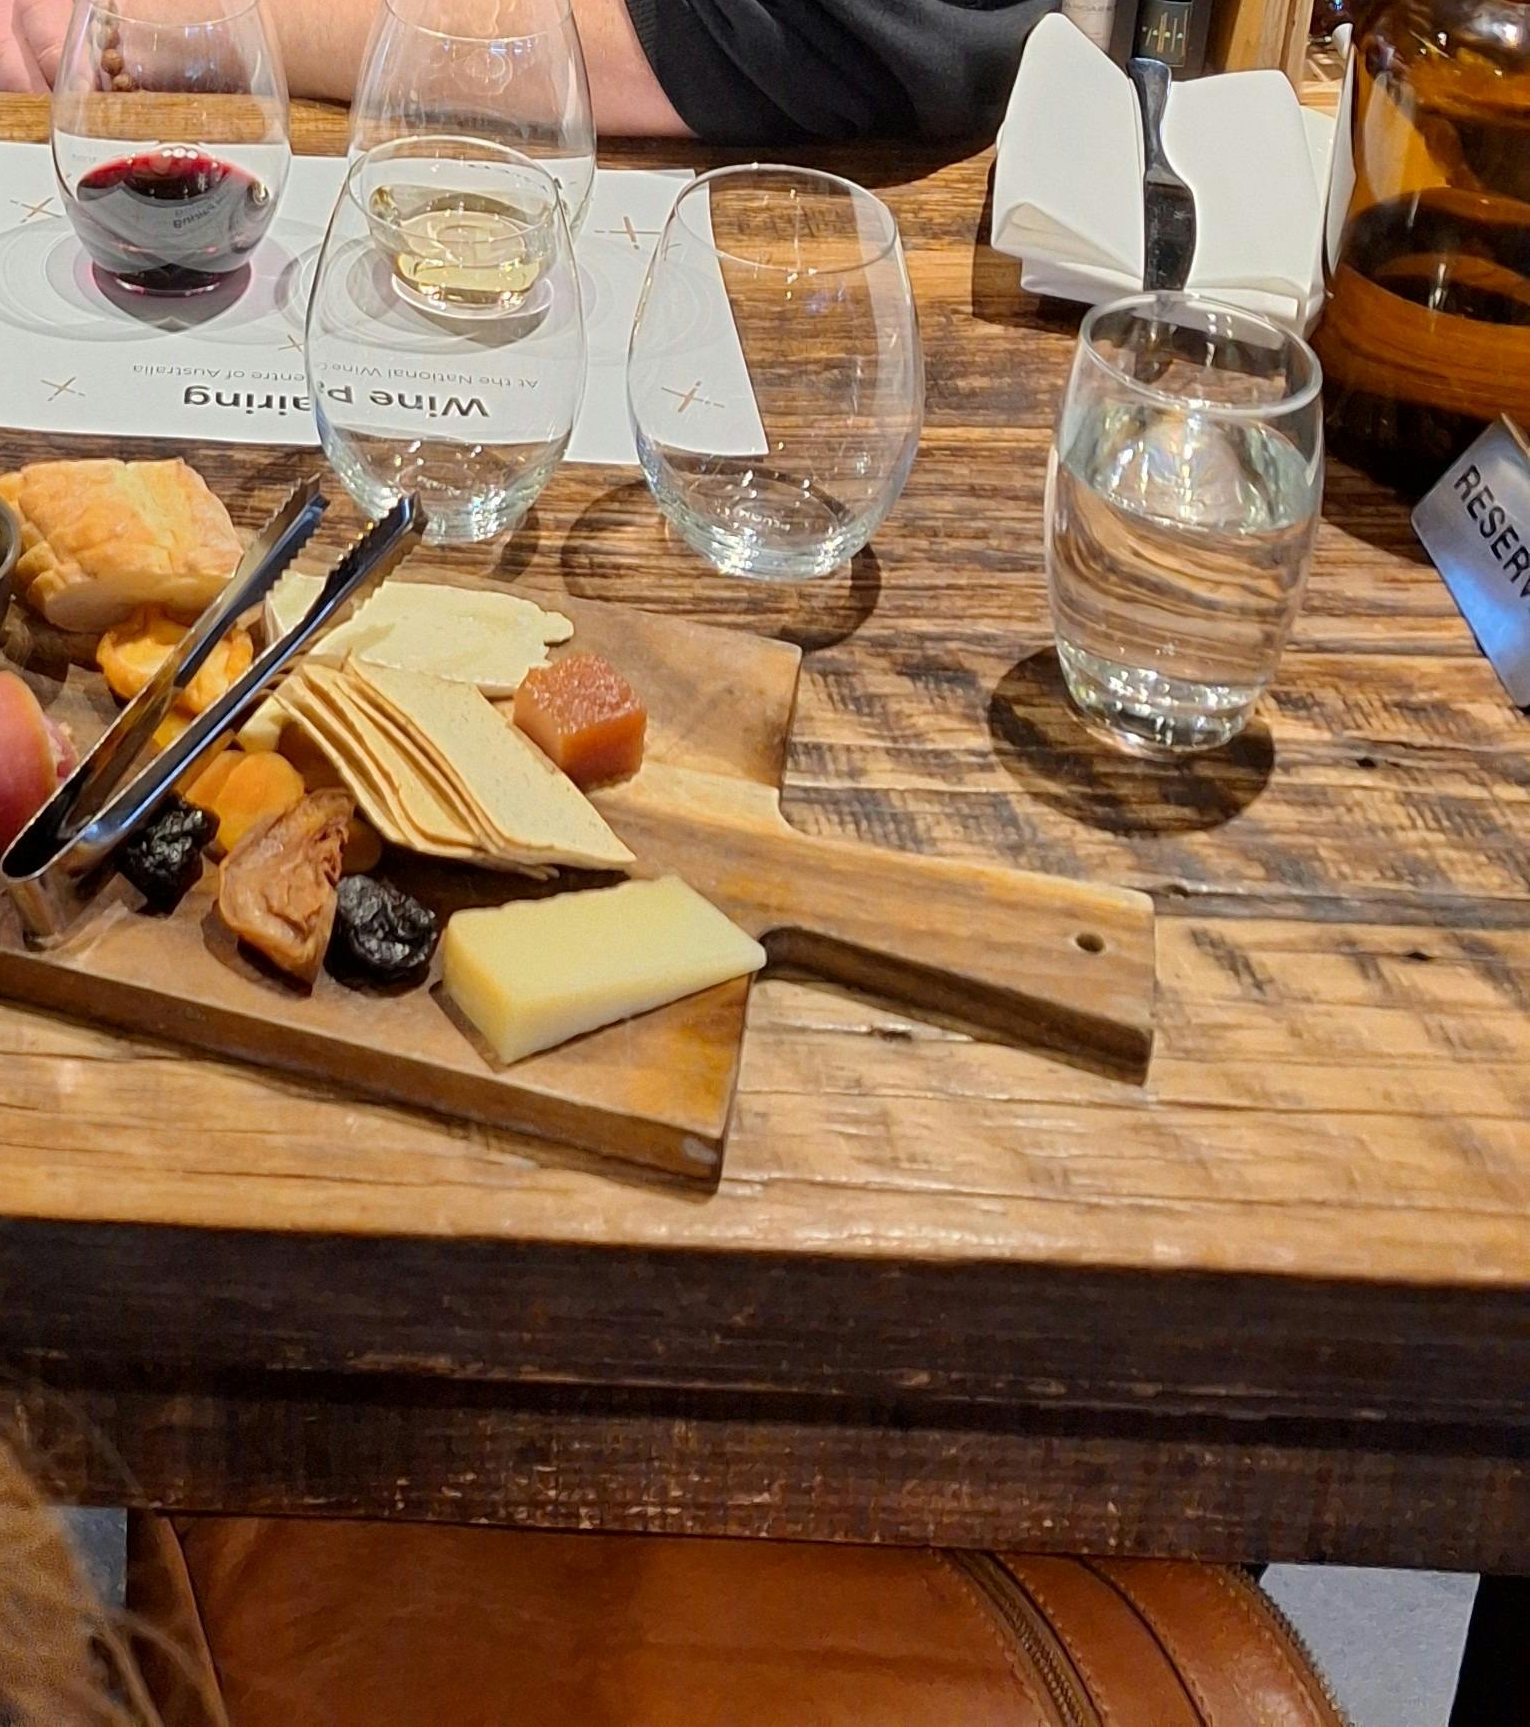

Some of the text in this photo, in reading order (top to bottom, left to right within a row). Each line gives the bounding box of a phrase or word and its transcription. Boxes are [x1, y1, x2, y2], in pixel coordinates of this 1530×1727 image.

[133, 363, 222, 379] Australia
[225, 368, 246, 380] of
[332, 363, 382, 378] Wine
[388, 367, 472, 385] National
[479, 376, 510, 388] the
[519, 379, 538, 389] At
[370, 390, 490, 418] Wine
